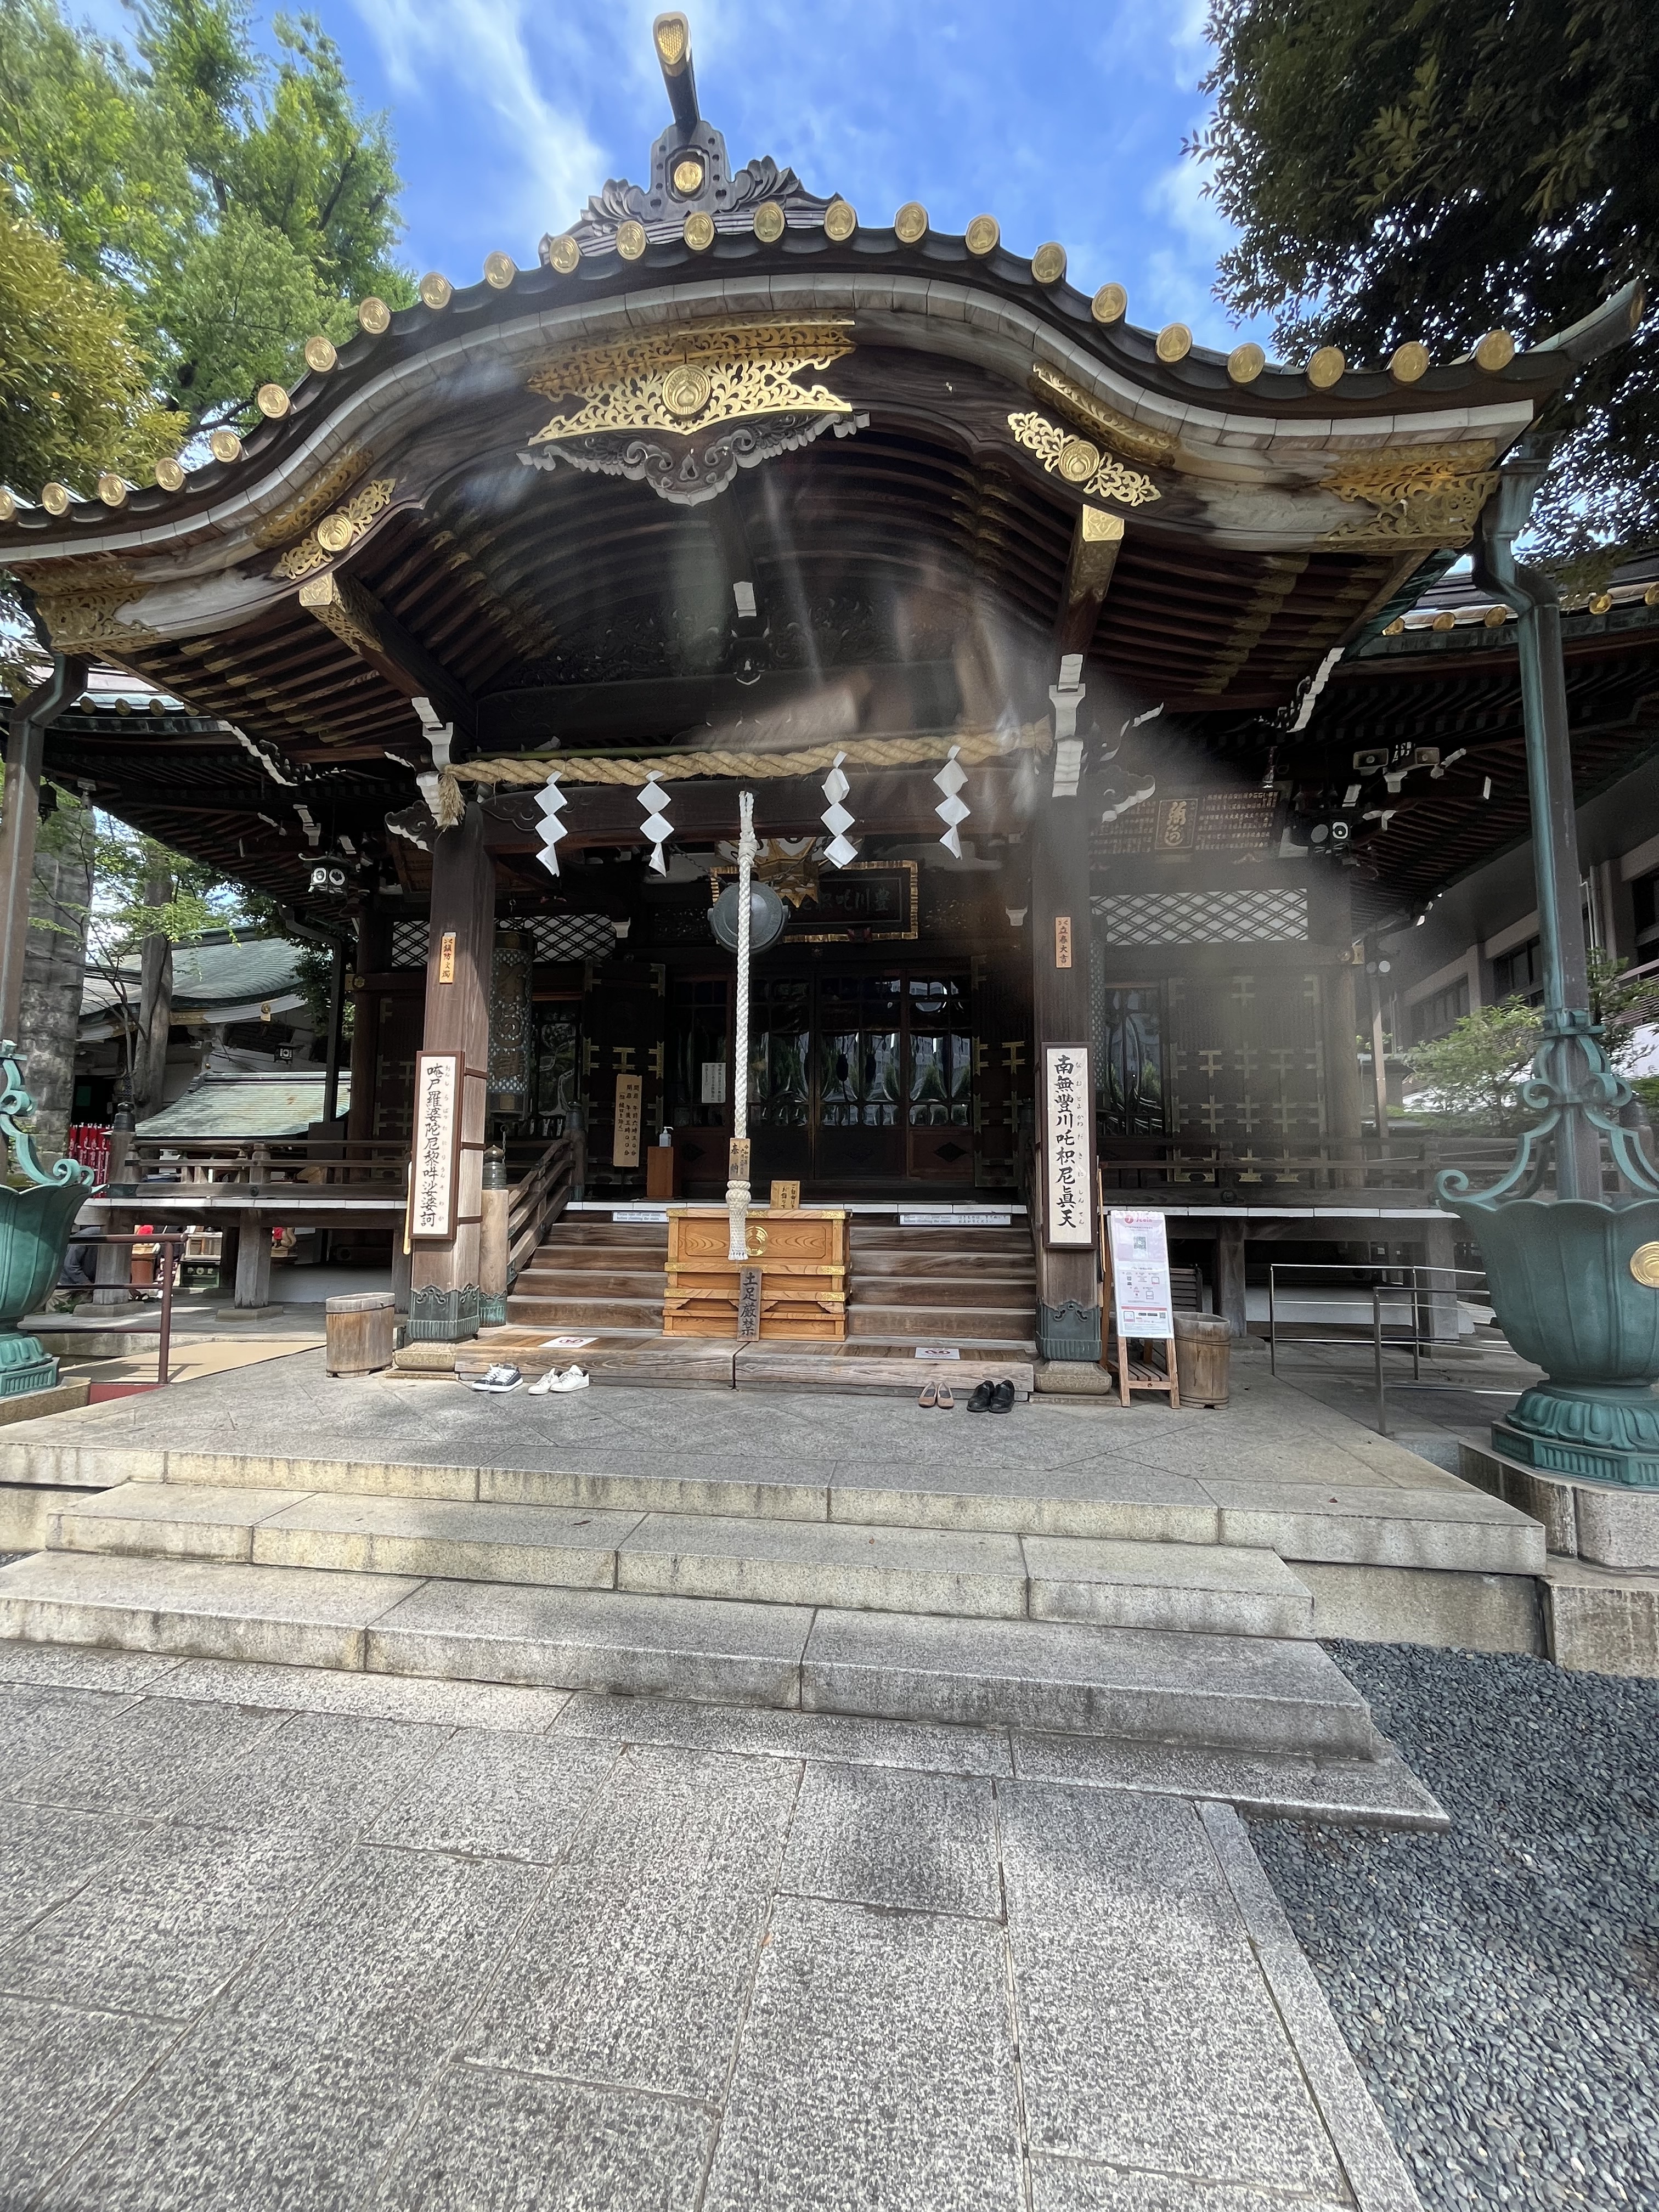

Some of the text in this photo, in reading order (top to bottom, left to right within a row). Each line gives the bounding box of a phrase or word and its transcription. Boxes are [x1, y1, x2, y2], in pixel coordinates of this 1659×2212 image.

[1058, 926, 1068, 963] 立春大吉
[741, 1272, 758, 1336] 土足厳禁
